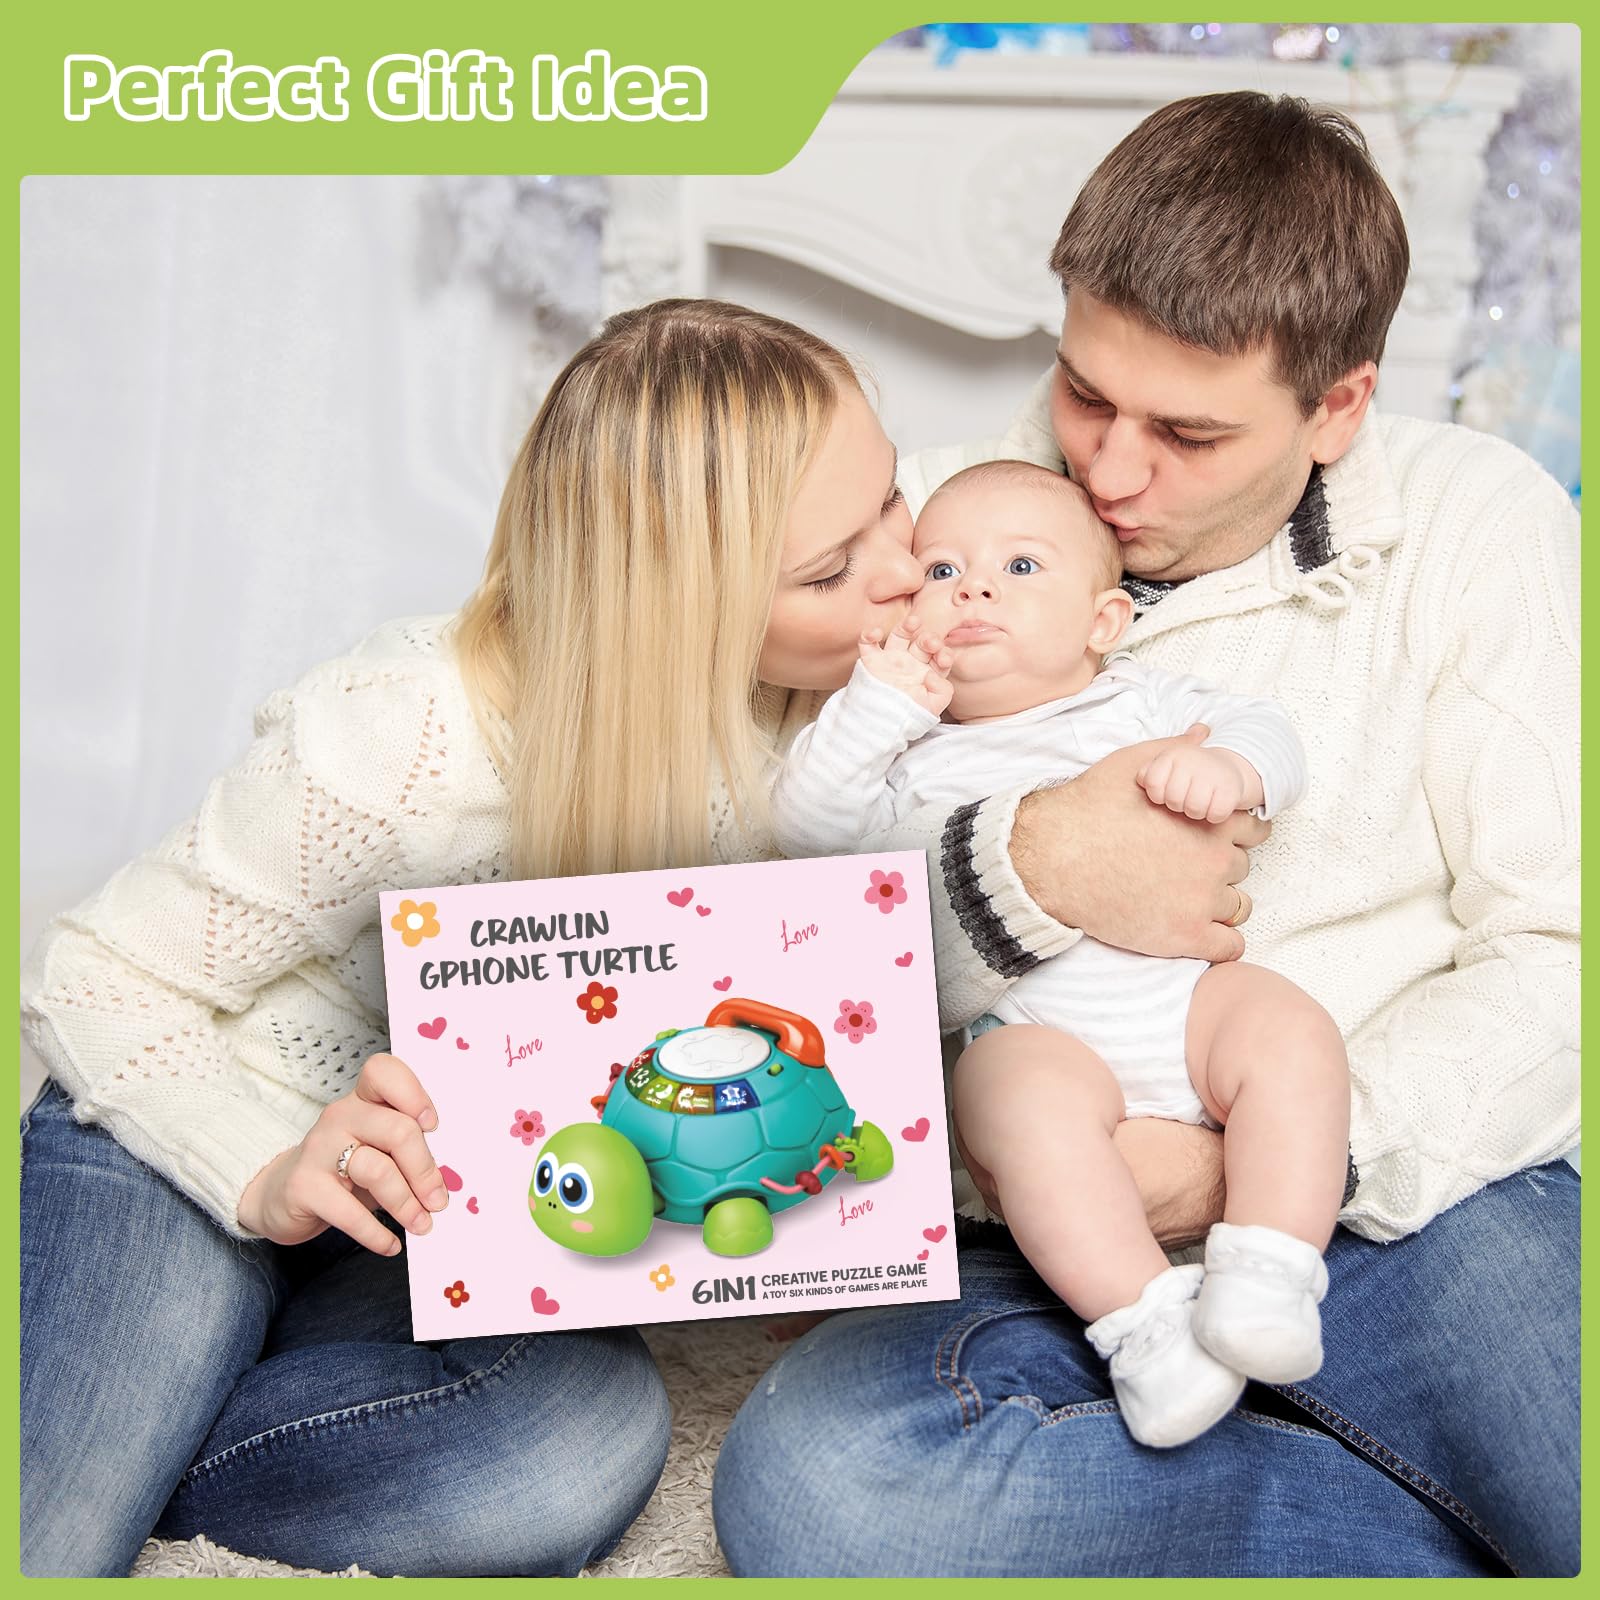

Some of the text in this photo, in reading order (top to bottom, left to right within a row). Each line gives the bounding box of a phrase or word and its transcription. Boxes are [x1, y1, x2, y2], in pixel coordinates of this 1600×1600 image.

[470, 910, 609, 948] CRAWLIN
[781, 920, 819, 952] Love
[420, 943, 679, 990] GPHONE TURTLE
[505, 1034, 543, 1067] Love
[838, 1196, 875, 1227] Love
[692, 1262, 927, 1305] 6IN1 CREATIVE PUZZLE GAME
[762, 1278, 928, 1300] A TOY SIX KINDS OF GAMES ARE PLAYE
